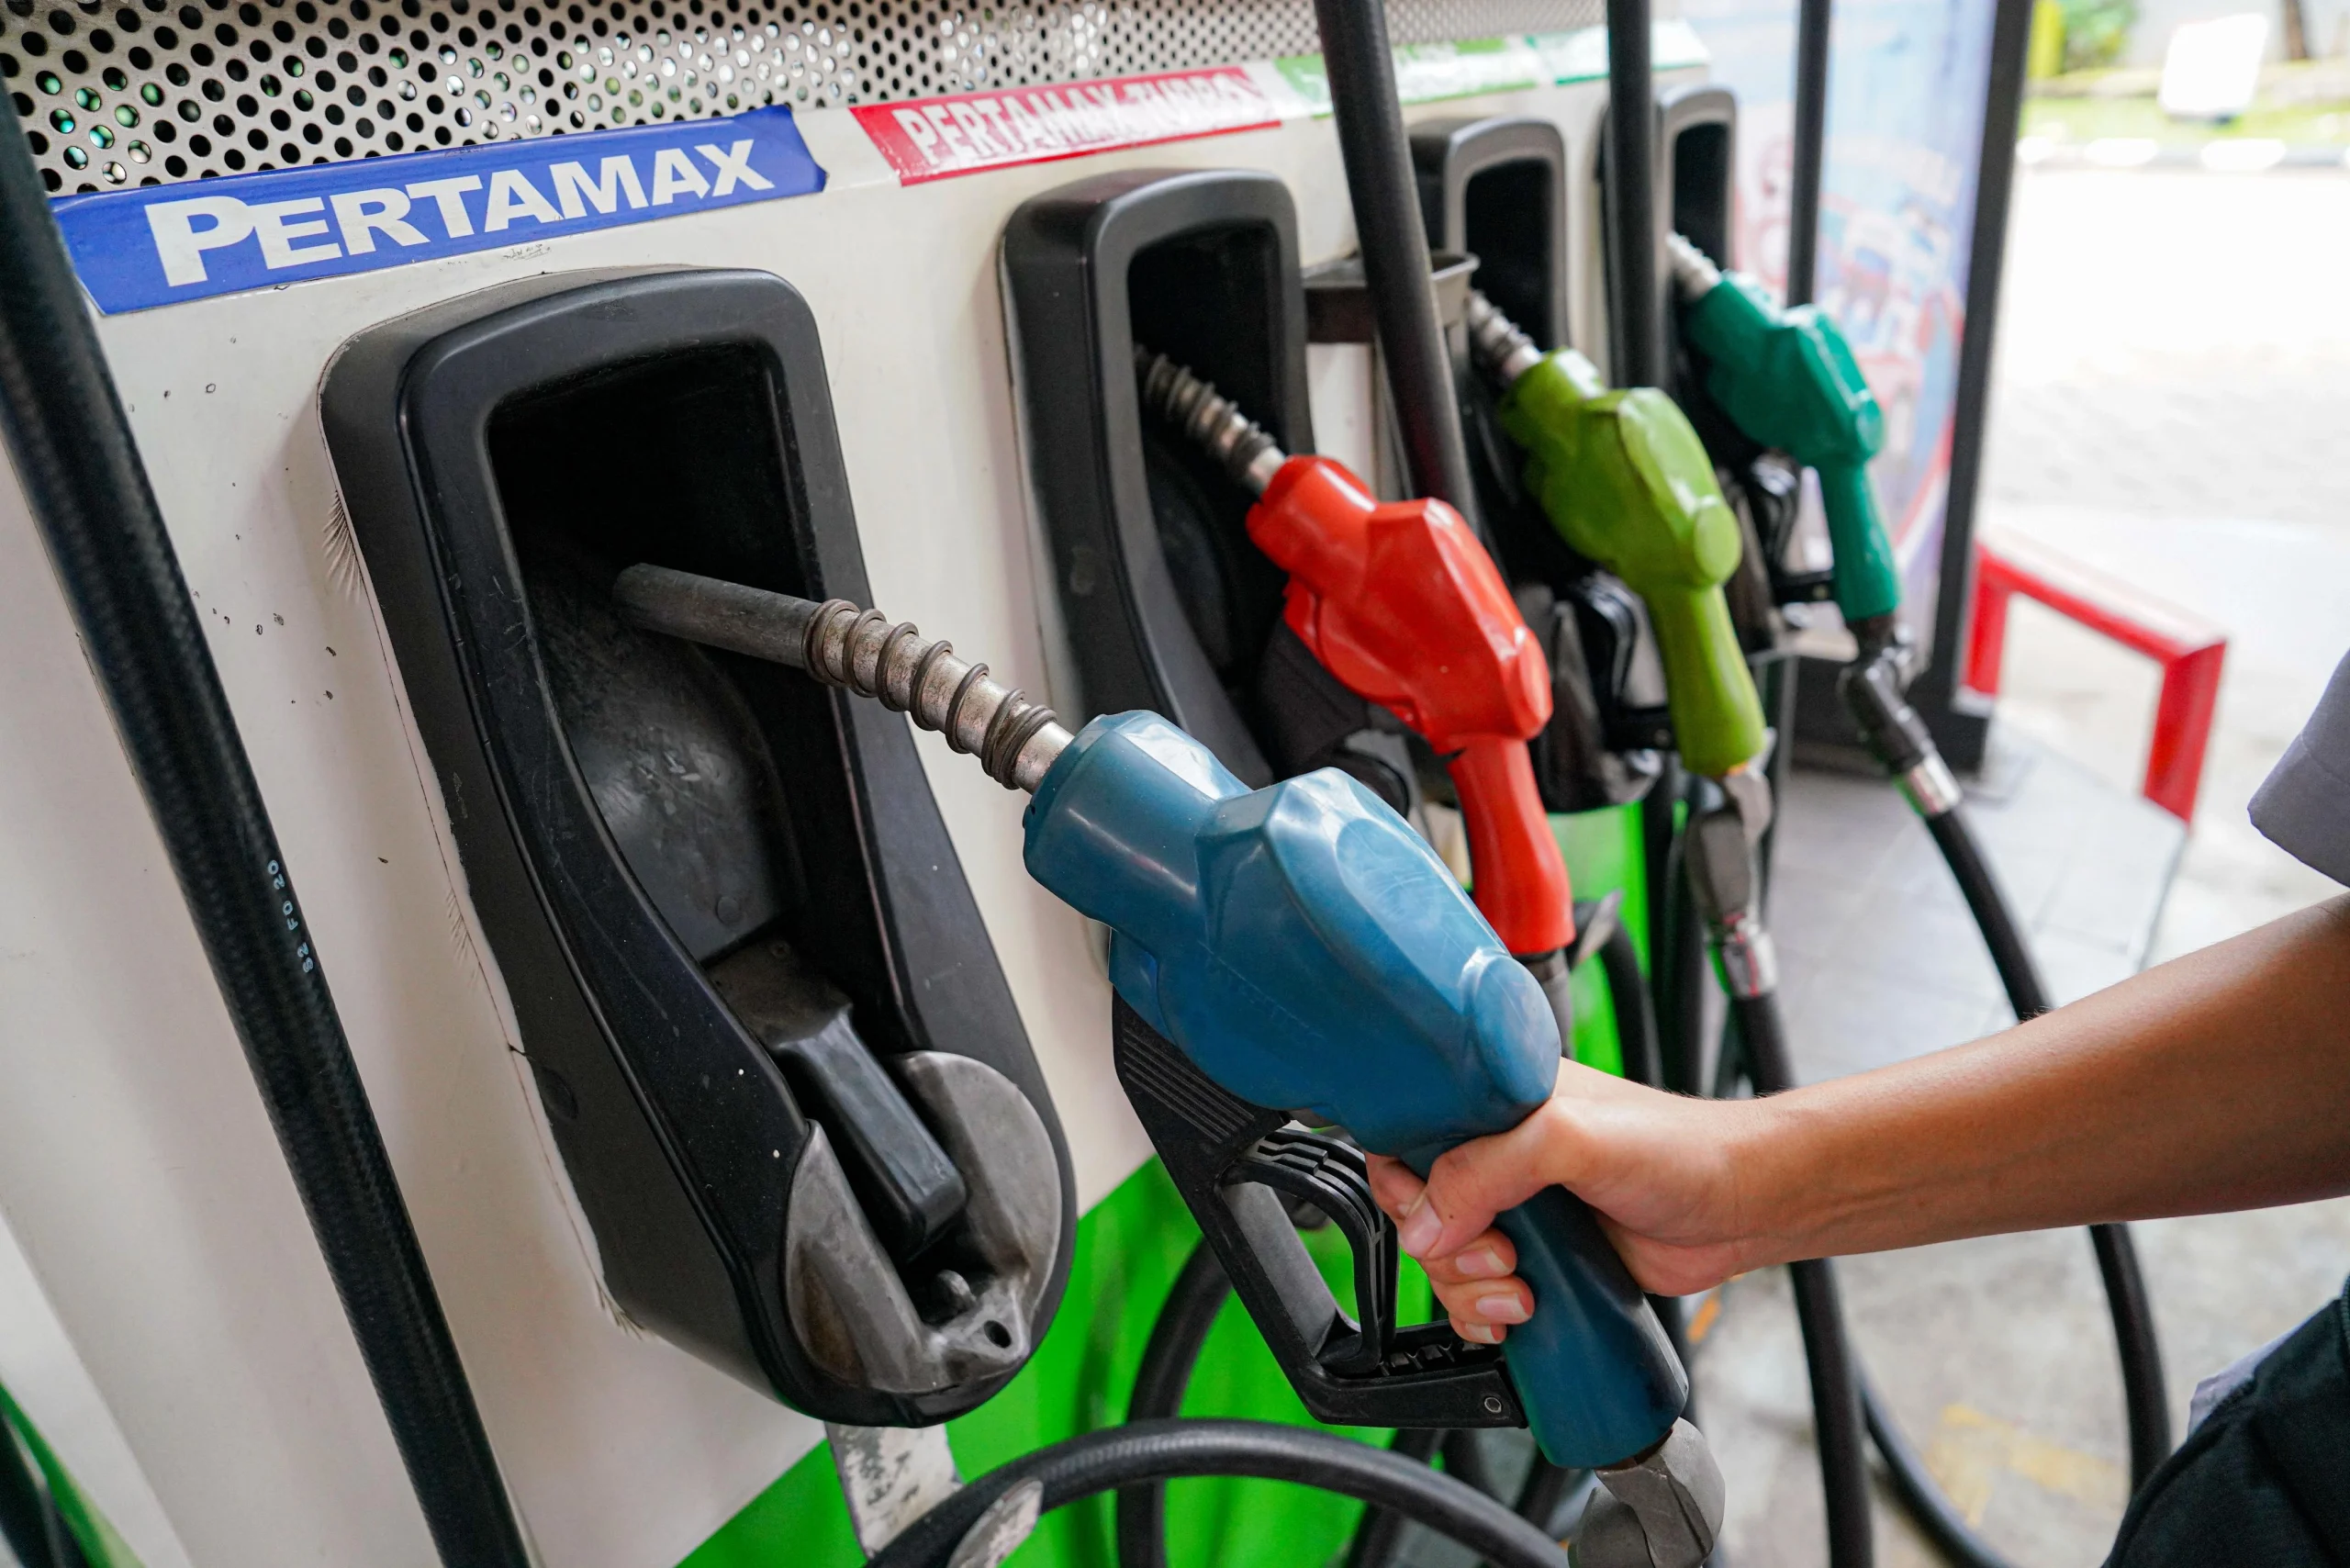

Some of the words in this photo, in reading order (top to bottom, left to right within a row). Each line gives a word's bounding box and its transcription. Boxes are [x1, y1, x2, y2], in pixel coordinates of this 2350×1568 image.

[891, 84, 1134, 165] PERTAMAX
[144, 139, 776, 287] PERTAMAX
[266, 859, 285, 890] 20
